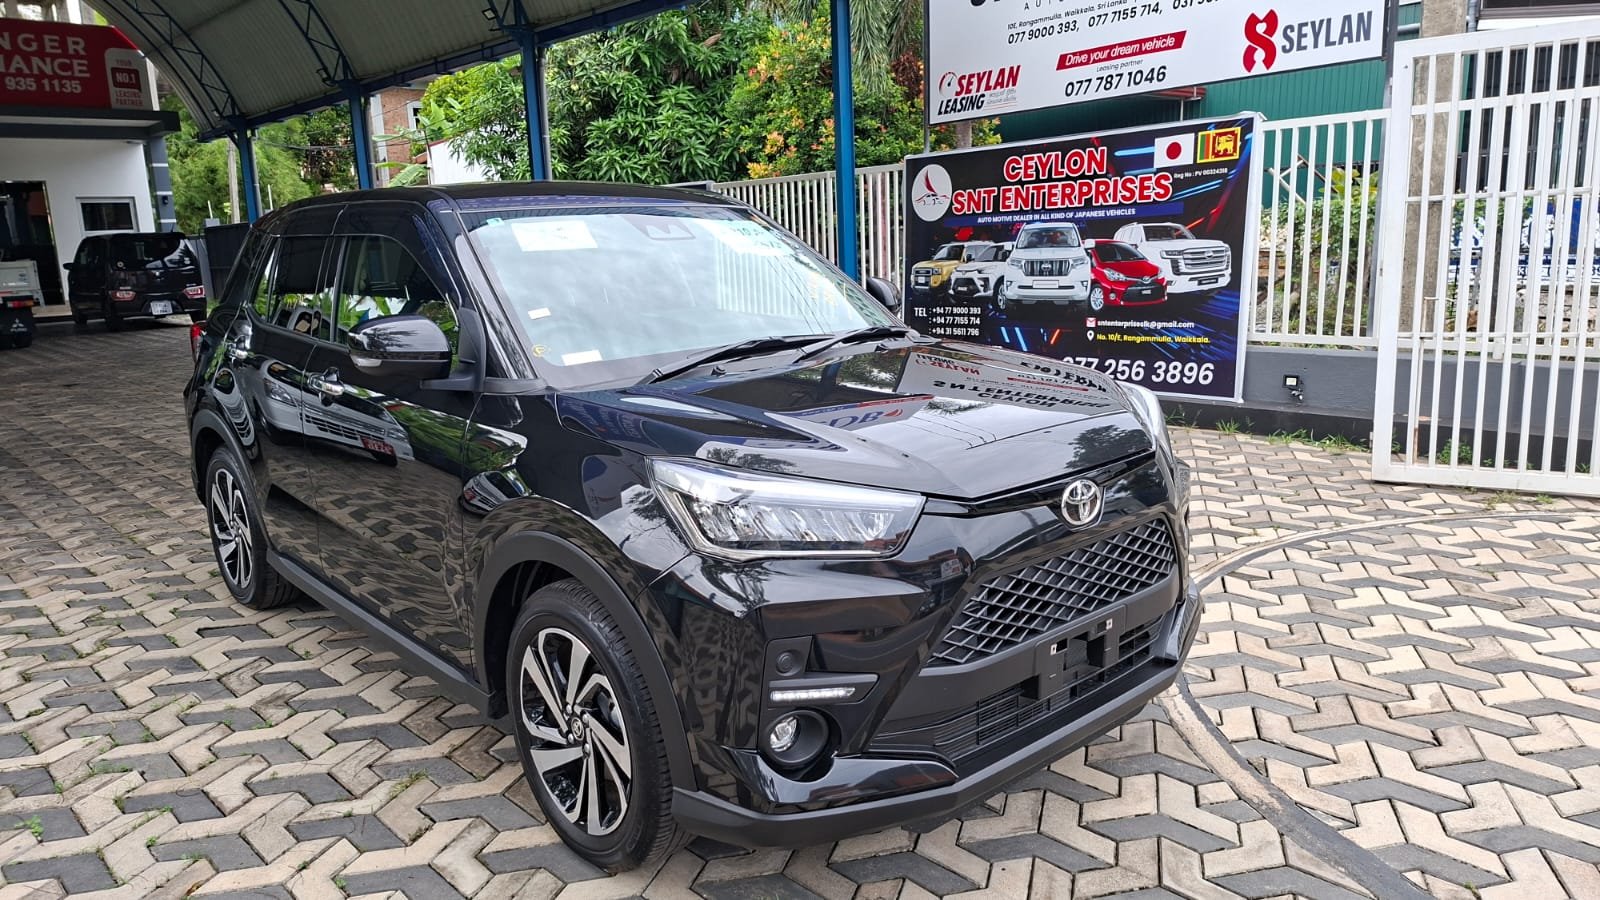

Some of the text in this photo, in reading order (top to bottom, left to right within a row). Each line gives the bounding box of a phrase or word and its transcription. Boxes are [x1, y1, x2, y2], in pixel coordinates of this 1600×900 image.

[1008, 31, 1027, 45] 077
[1027, 25, 1055, 41] 9000
[1056, 19, 1080, 35] 393,
[1088, 13, 1109, 28] 077
[1110, 6, 1138, 24] 7155
[1140, 1, 1162, 17] 714,
[1281, 10, 1373, 54] SEYLAN
[1065, 35, 1176, 66] Drive your dream vehicle
[115, 72, 136, 84] NO.1
[1096, 59, 1144, 73] Leasing partner
[5, 76, 82, 94] 935 1135
[955, 64, 1021, 97] SEYLAN
[1065, 65, 1168, 97] 077 787 1046
[937, 93, 986, 116] LEASING
[1003, 147, 1107, 182] CEYLON
[951, 171, 1173, 215] SNT ENTERPRISES
[1013, 214, 1033, 222] DEALER
[1050, 212, 1065, 220] KIND
[1074, 210, 1106, 219] JAPANESE
[1106, 208, 1136, 217] VEHICLES
[913, 307, 928, 317] TEL
[944, 306, 952, 314] 77
[945, 316, 953, 325] 77
[953, 316, 969, 325] 7155
[969, 316, 981, 325] 714
[1103, 359, 1146, 382] 256
[1151, 360, 1215, 385] 3896
